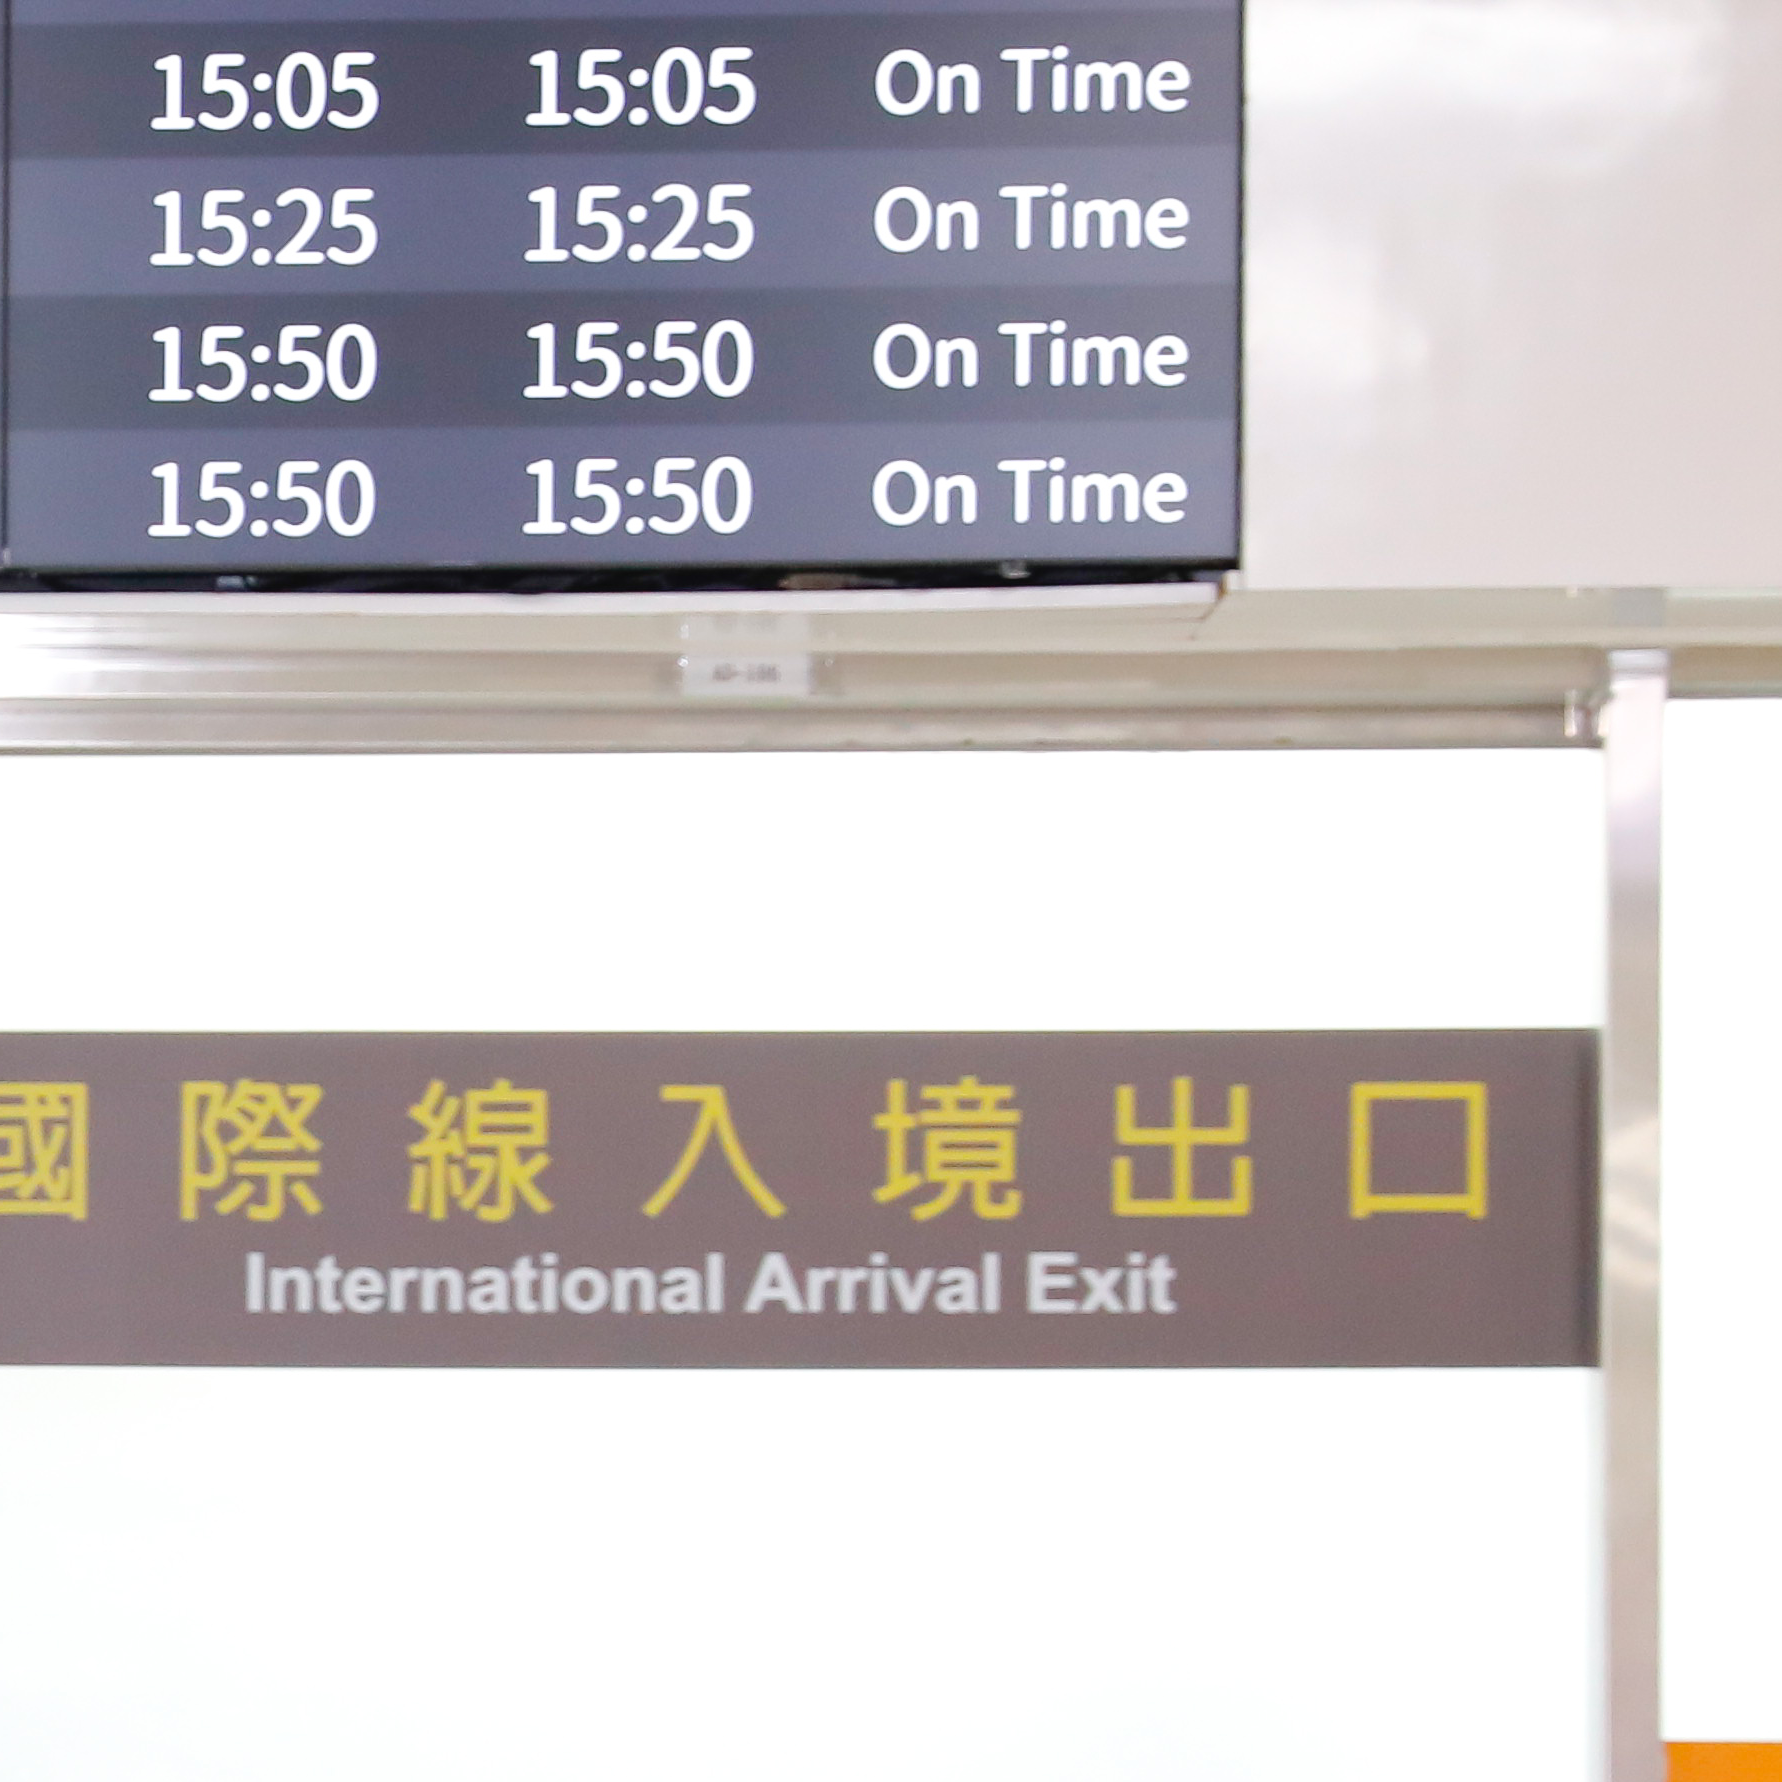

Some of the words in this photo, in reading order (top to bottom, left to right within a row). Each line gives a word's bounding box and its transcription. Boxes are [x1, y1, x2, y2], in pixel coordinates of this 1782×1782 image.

[152, 52, 377, 129] 15:05
[527, 48, 754, 125] 15:05
[877, 50, 978, 114] On
[1001, 46, 1189, 111] Time
[151, 189, 376, 265] 15:25
[526, 184, 753, 261] 15:25
[875, 187, 978, 251] On
[1000, 183, 1188, 248] Time
[150, 324, 375, 401] 15:50
[525, 320, 752, 397] 15:50
[875, 324, 977, 388] On
[999, 321, 1187, 385] Time
[149, 460, 374, 536] 15:50
[524, 457, 751, 534] 15:50
[874, 461, 976, 525] On
[998, 458, 1187, 522] Time
[248, 1253, 722, 1312] International
[746, 1254, 998, 1312] Arrival
[1030, 1253, 1173, 1312] Exit
